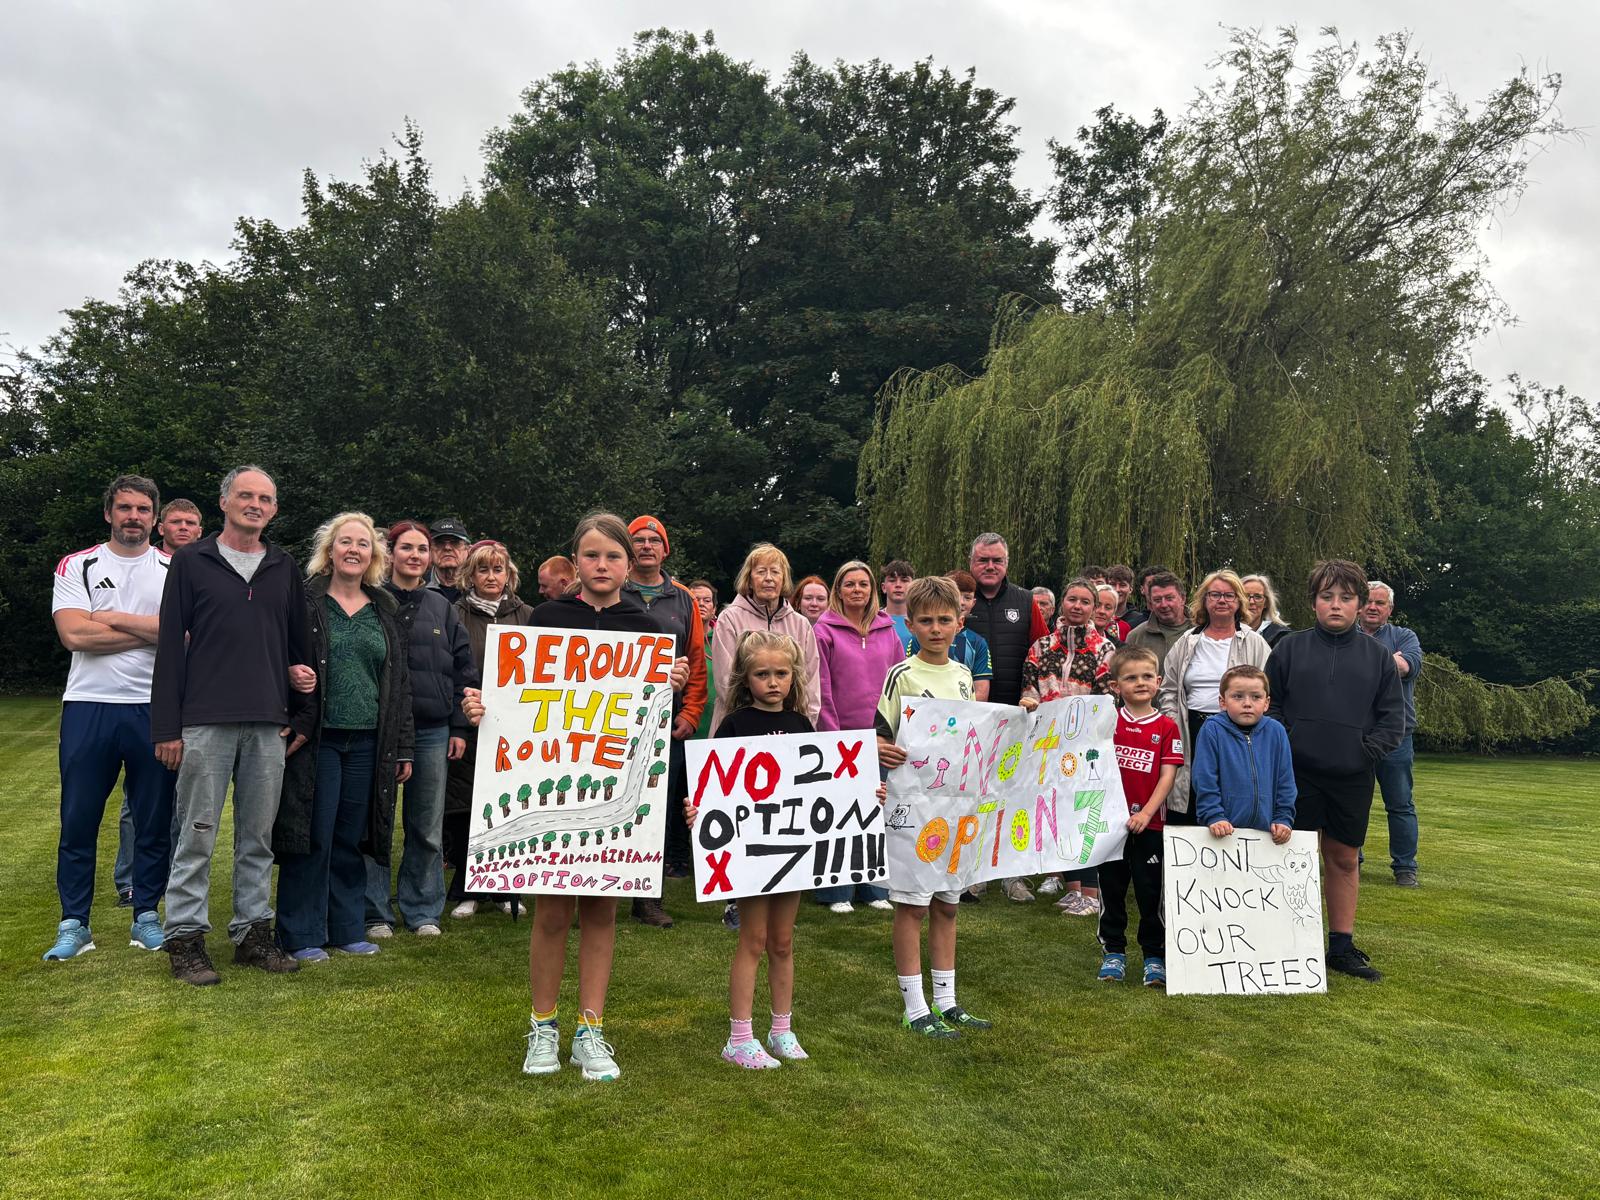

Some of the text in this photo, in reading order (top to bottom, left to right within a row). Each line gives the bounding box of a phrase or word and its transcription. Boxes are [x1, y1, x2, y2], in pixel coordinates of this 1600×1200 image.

[497, 632, 673, 687] REROUTE
[519, 689, 632, 737] THE
[495, 733, 629, 773] ROUTE
[1115, 746, 1152, 760] PORTS
[1117, 757, 1149, 771] RECT
[693, 747, 781, 808] NO
[699, 797, 881, 850] OPTION
[469, 862, 521, 877] SAYING
[1176, 878, 1279, 915] KNOCK
[1177, 924, 1256, 955] OUR
[1207, 957, 1322, 993] TREES
